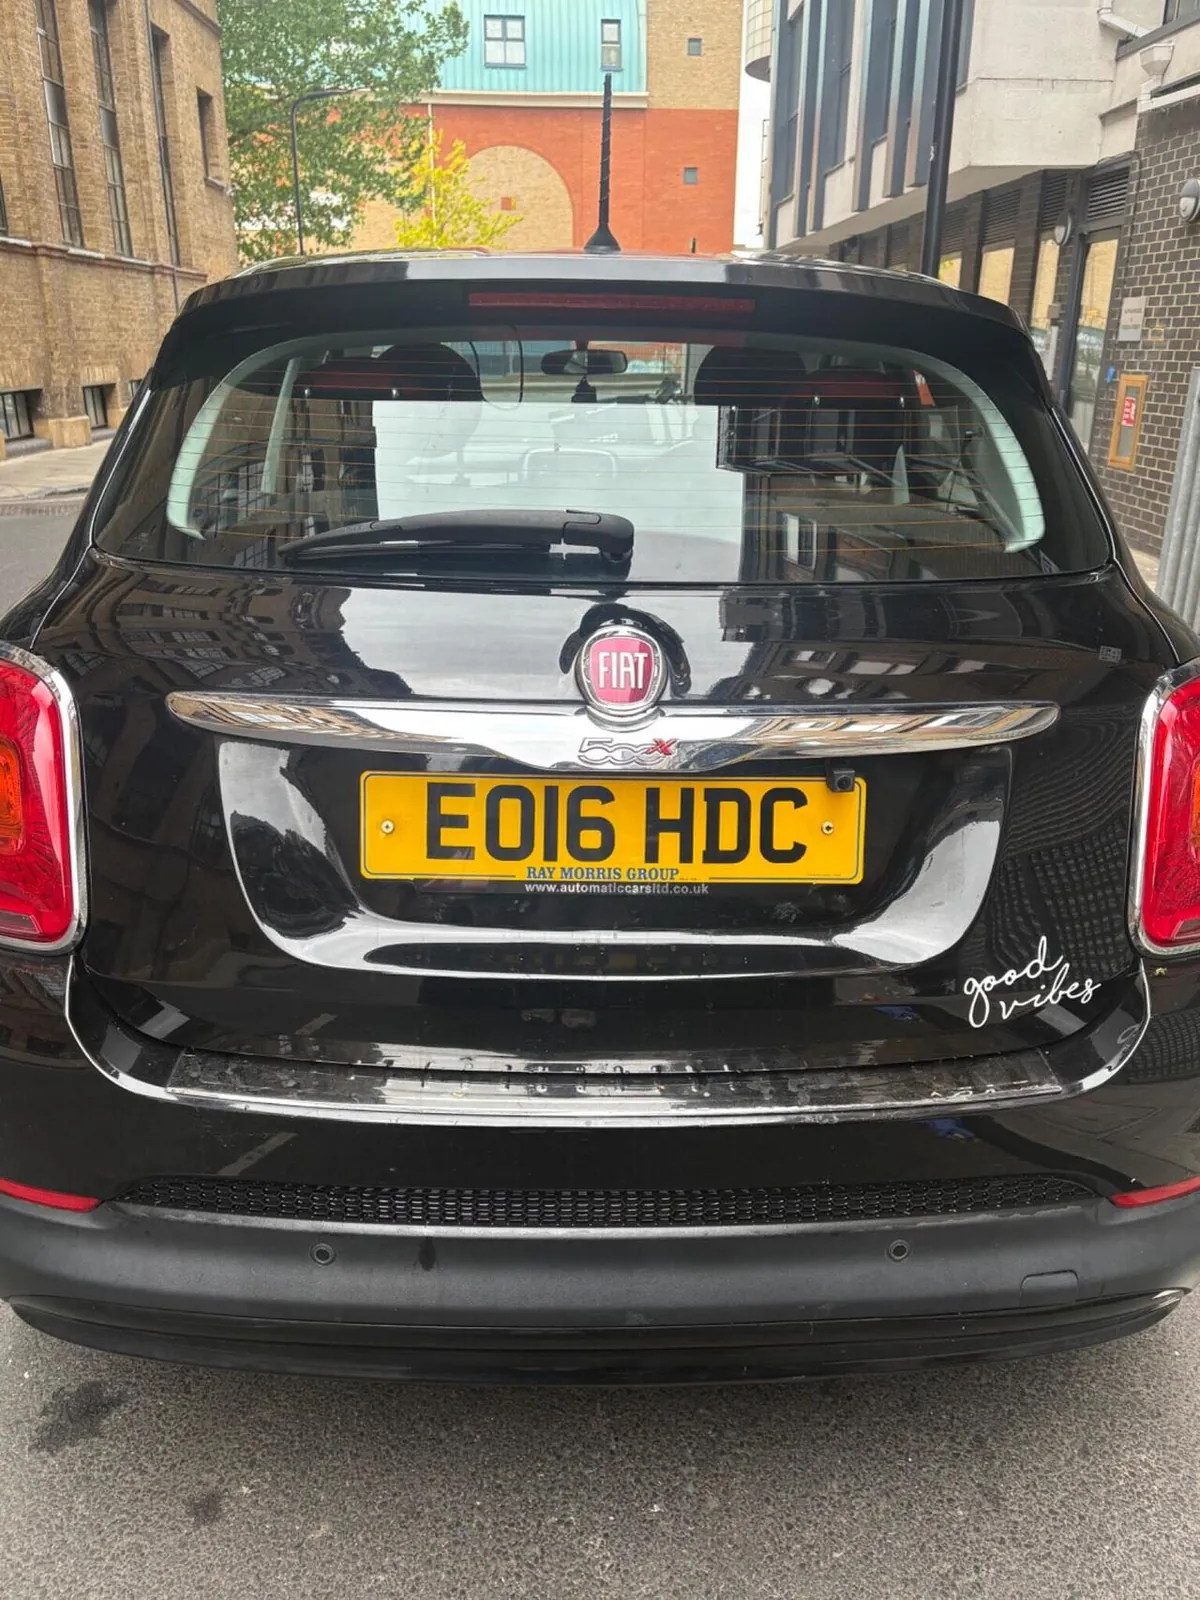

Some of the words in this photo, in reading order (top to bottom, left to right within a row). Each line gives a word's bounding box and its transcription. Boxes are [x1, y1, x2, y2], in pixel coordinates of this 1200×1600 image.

[598, 651, 649, 689] FIAT
[427, 782, 615, 862] EO16
[645, 787, 808, 864] HDC
[525, 882, 709, 895] www.automaticcarsltd.co.uk
[526, 866, 556, 880] RAY
[560, 867, 622, 881] MORRIS
[627, 868, 680, 881] GROUP
[964, 936, 1064, 1028] good
[1000, 963, 1102, 1020] vibes
